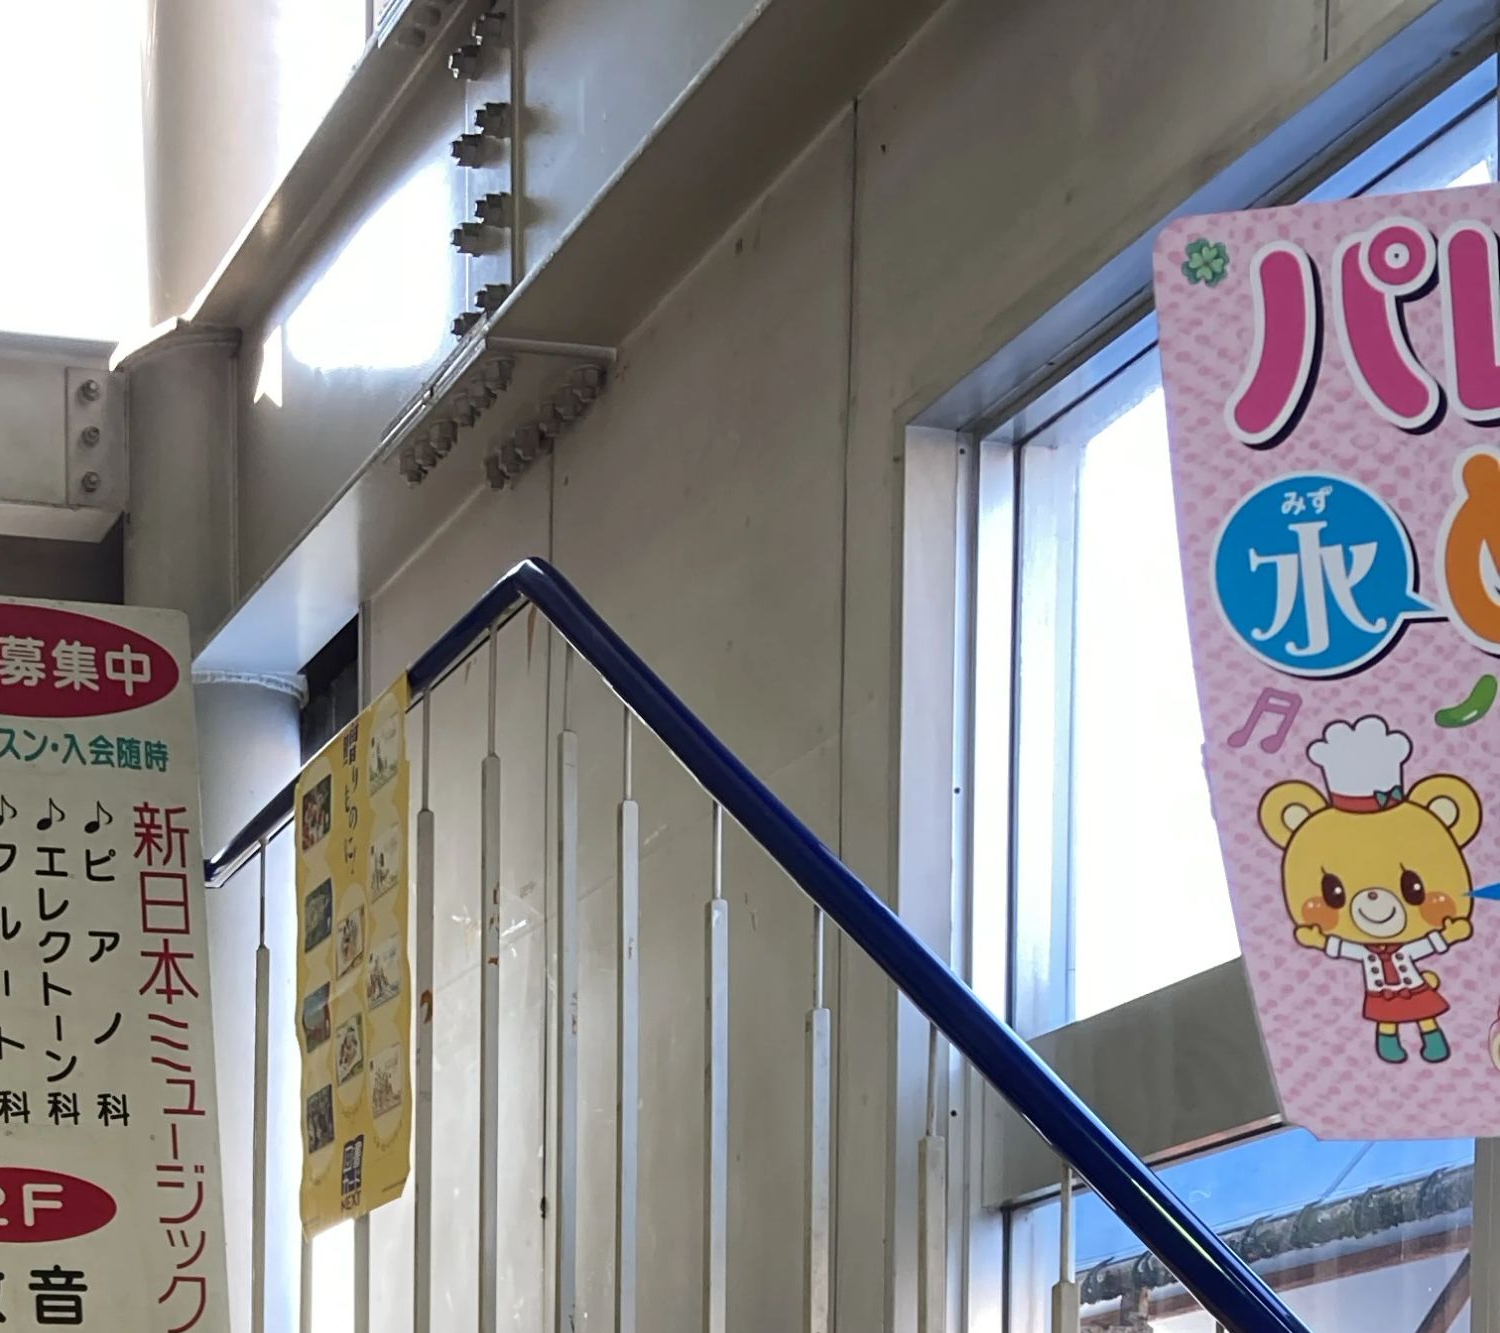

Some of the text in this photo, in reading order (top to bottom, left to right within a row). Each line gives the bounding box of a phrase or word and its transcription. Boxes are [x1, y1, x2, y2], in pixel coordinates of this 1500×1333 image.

[1248, 520, 1387, 657] 水
[1281, 485, 1333, 515] みず
[35, 846, 80, 1125] エレクトーン科
[84, 847, 130, 1126] ピアノ科
